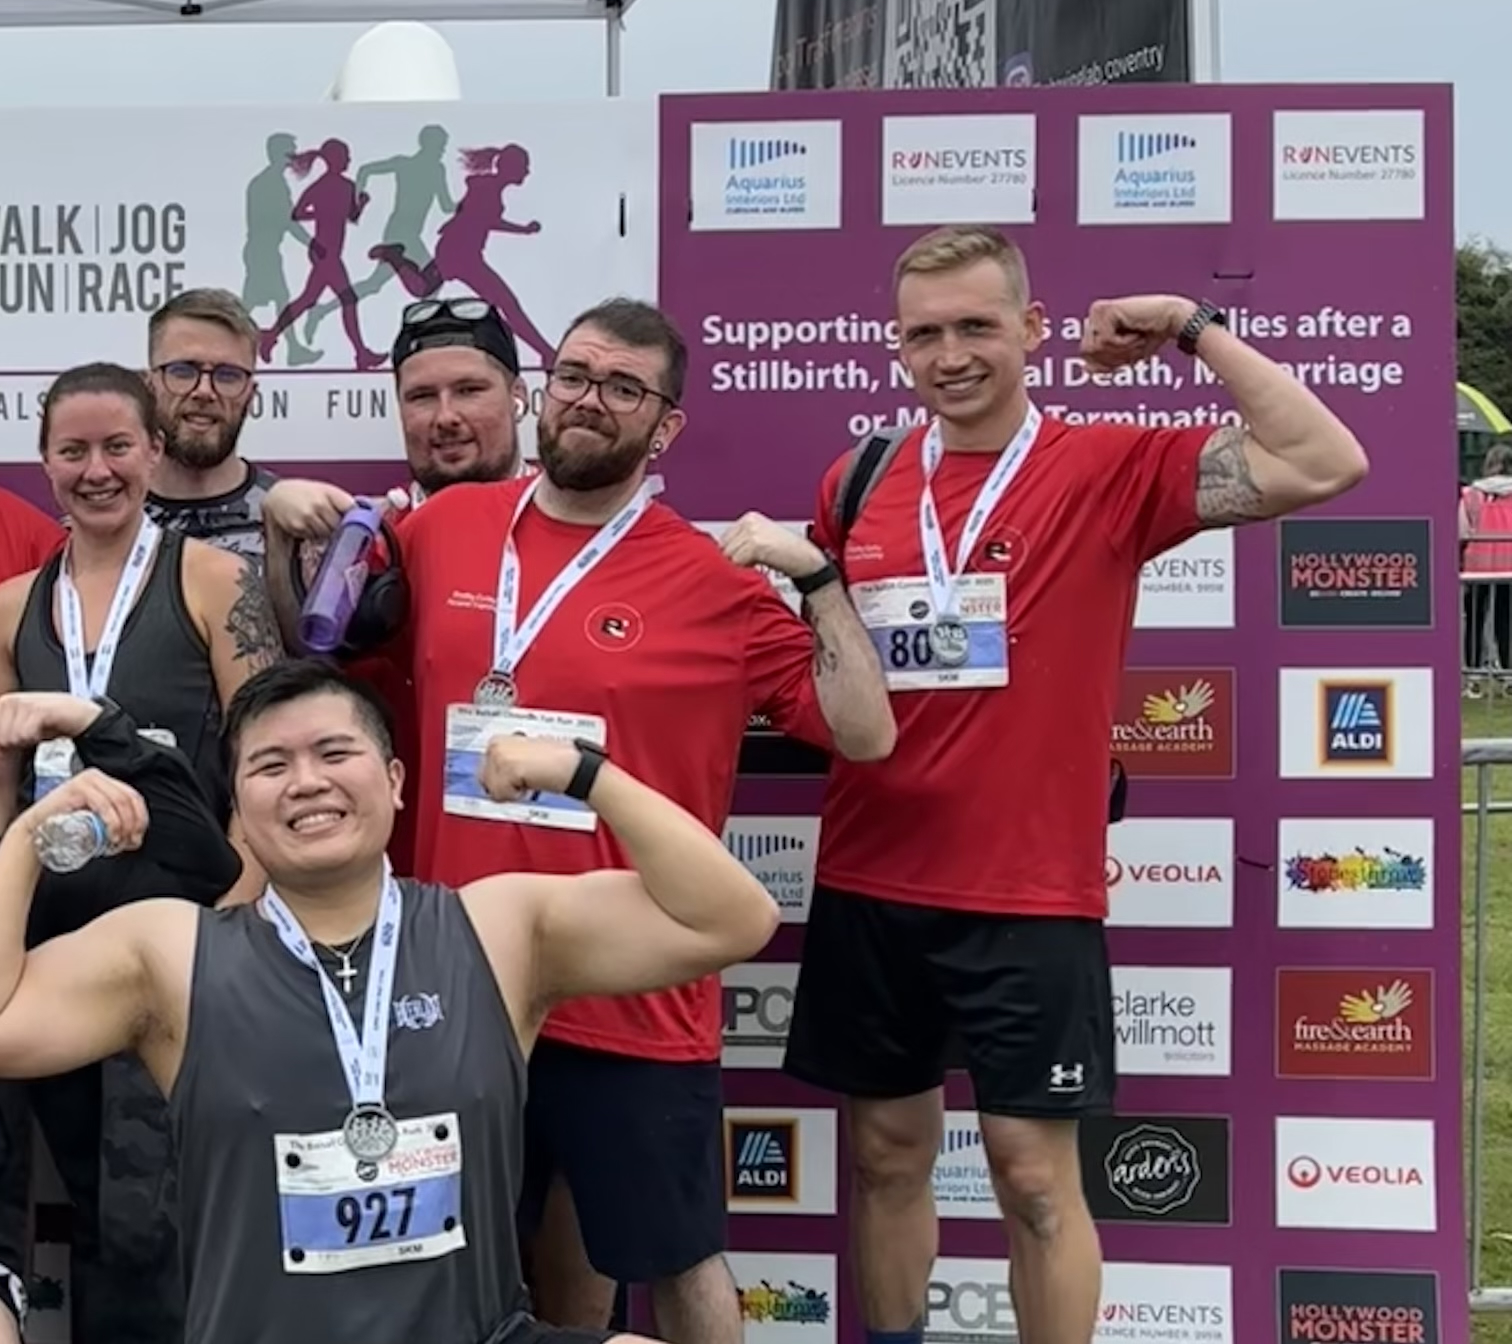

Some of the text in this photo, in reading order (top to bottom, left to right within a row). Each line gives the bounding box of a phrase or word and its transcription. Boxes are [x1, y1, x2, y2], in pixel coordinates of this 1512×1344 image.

[726, 175, 805, 192] Aquarius
[938, 174, 986, 185] Number
[1115, 169, 1195, 186] Aquarius
[1329, 170, 1376, 180] Number
[109, 203, 186, 255] JOG
[702, 314, 901, 352] Supporting
[1297, 306, 1383, 338] after
[1392, 314, 1411, 338] a
[711, 360, 880, 393] Stillbirth,
[327, 389, 388, 420] FUN
[848, 412, 886, 436] or
[1290, 553, 1418, 568] HOLLYWOOD
[1290, 568, 1419, 589] MONSTER
[889, 628, 934, 668] 80
[1111, 717, 1213, 741] re&earth
[1330, 732, 1383, 750] ALDI
[1128, 864, 1222, 883] VEOLIA
[780, 887, 804, 899] Ltd
[1112, 990, 1196, 1018] clarke
[1114, 1019, 1215, 1046] willmott
[1294, 1016, 1412, 1041] fire&earth
[1353, 1042, 1412, 1052] ACADEMY
[388, 1150, 457, 1174] MONSTER
[737, 1169, 787, 1186] ALDI
[1326, 1164, 1424, 1186] VEOLIA
[334, 1185, 416, 1244] 927
[1290, 1304, 1424, 1322] HOLLYWOOD
[1290, 1319, 1425, 1344] MONSTER
